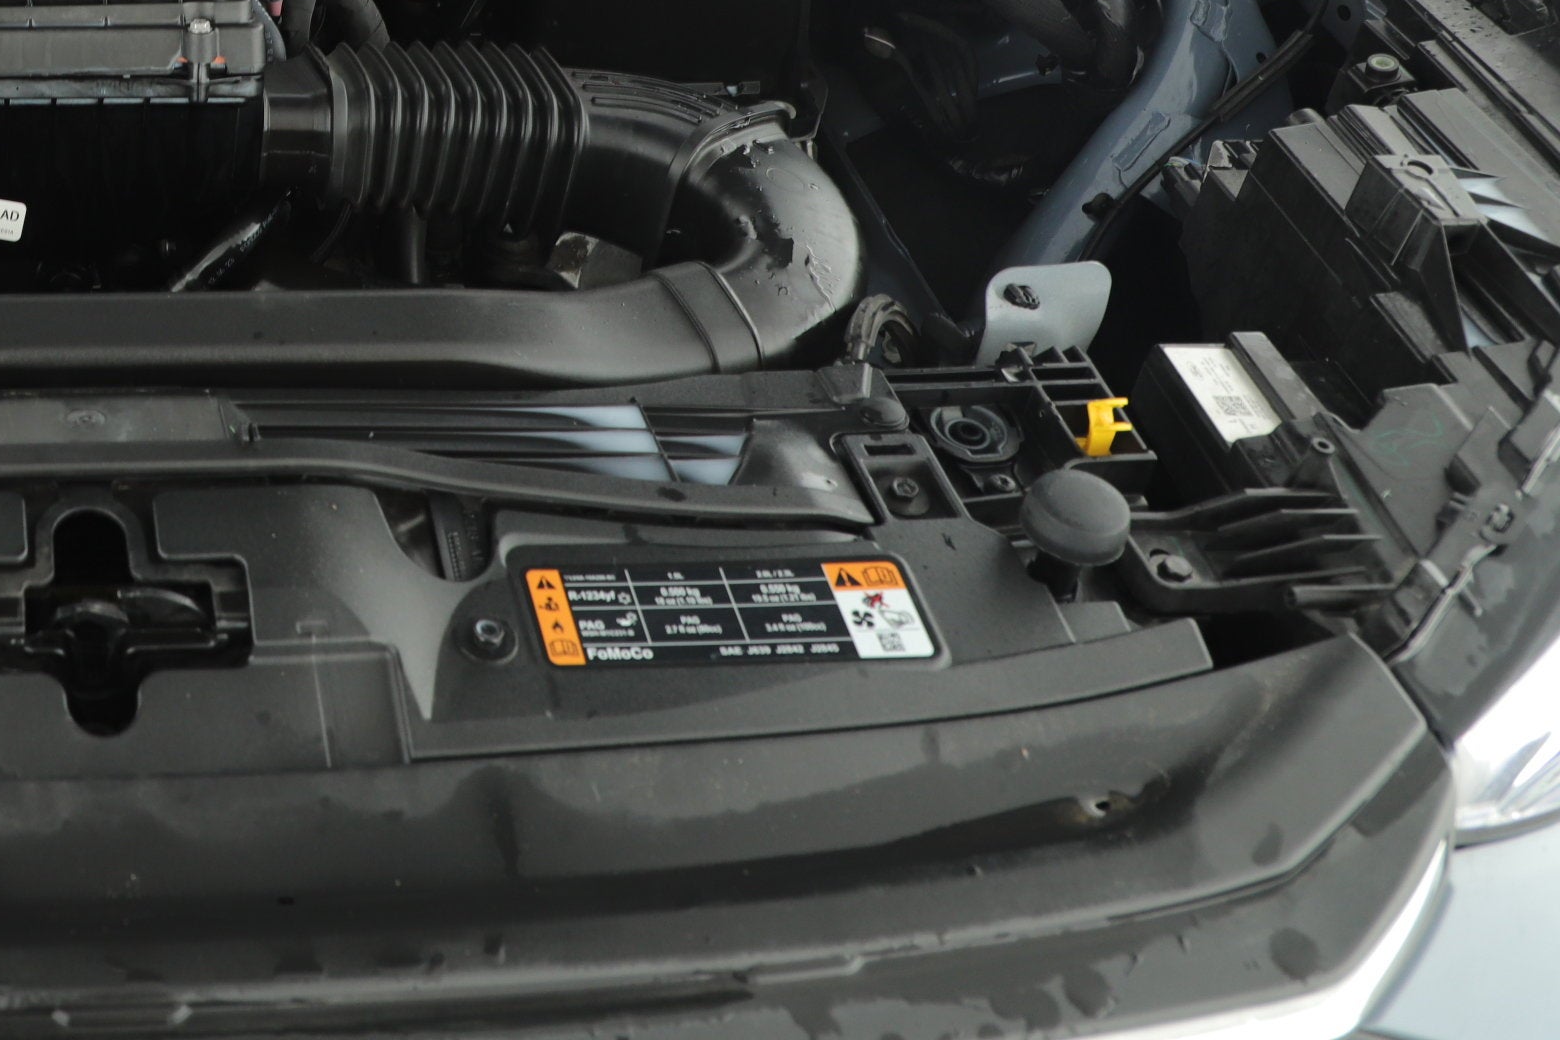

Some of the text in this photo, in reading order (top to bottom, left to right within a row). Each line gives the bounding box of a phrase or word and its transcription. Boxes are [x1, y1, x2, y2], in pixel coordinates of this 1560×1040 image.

[0, 210, 20, 222] AD
[567, 590, 616, 603] R-1234yf
[680, 615, 701, 625] PAG
[781, 613, 802, 623] PAG
[578, 619, 606, 631] PAG
[586, 647, 654, 660] FoMoCo
[719, 645, 743, 656] SAE
